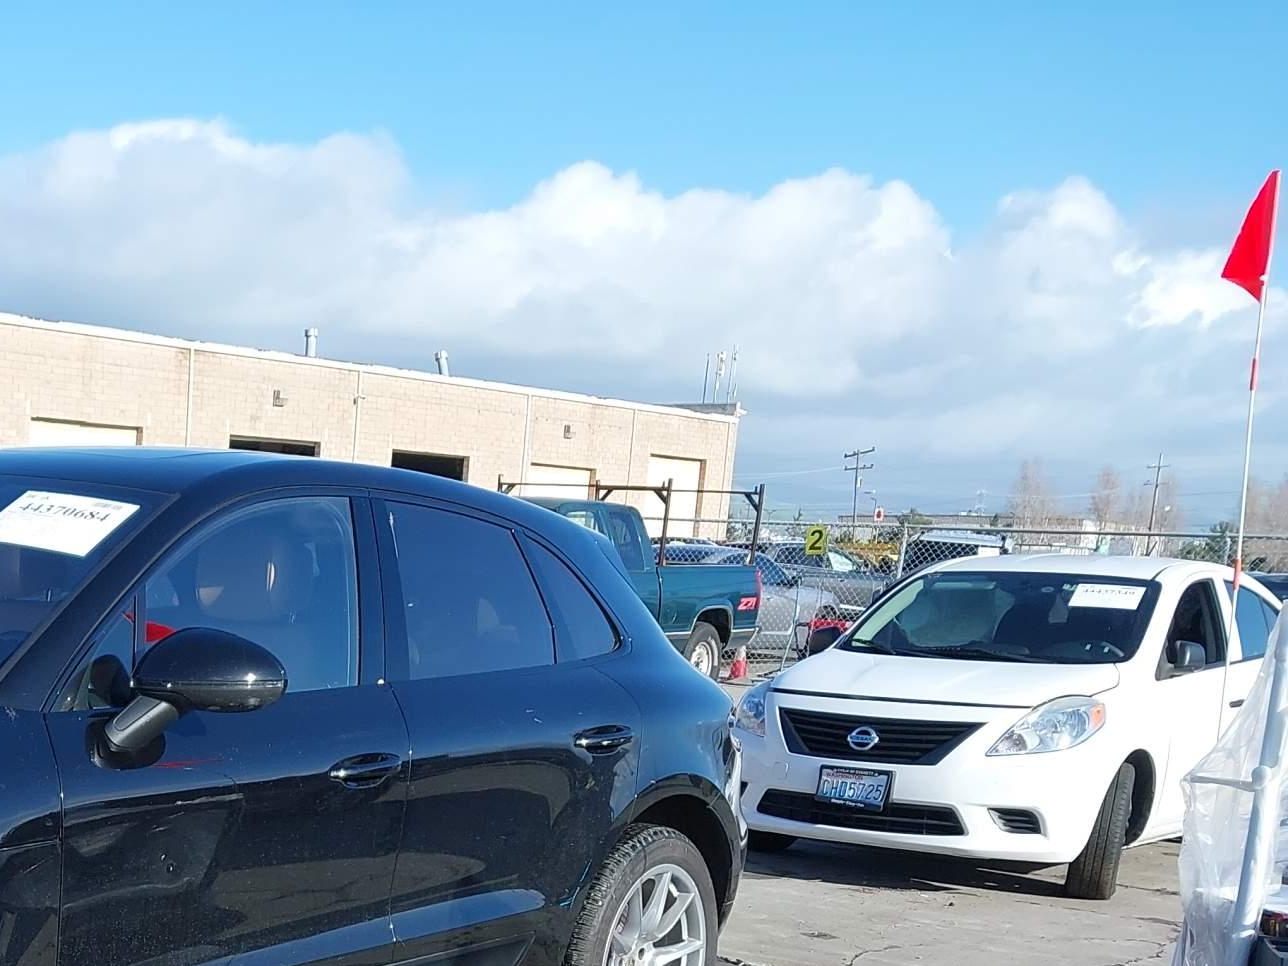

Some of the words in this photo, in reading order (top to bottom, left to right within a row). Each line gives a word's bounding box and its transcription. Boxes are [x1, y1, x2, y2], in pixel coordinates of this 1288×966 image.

[19, 502, 111, 522] 44370684
[807, 529, 824, 551] 2
[737, 597, 757, 611] Z71
